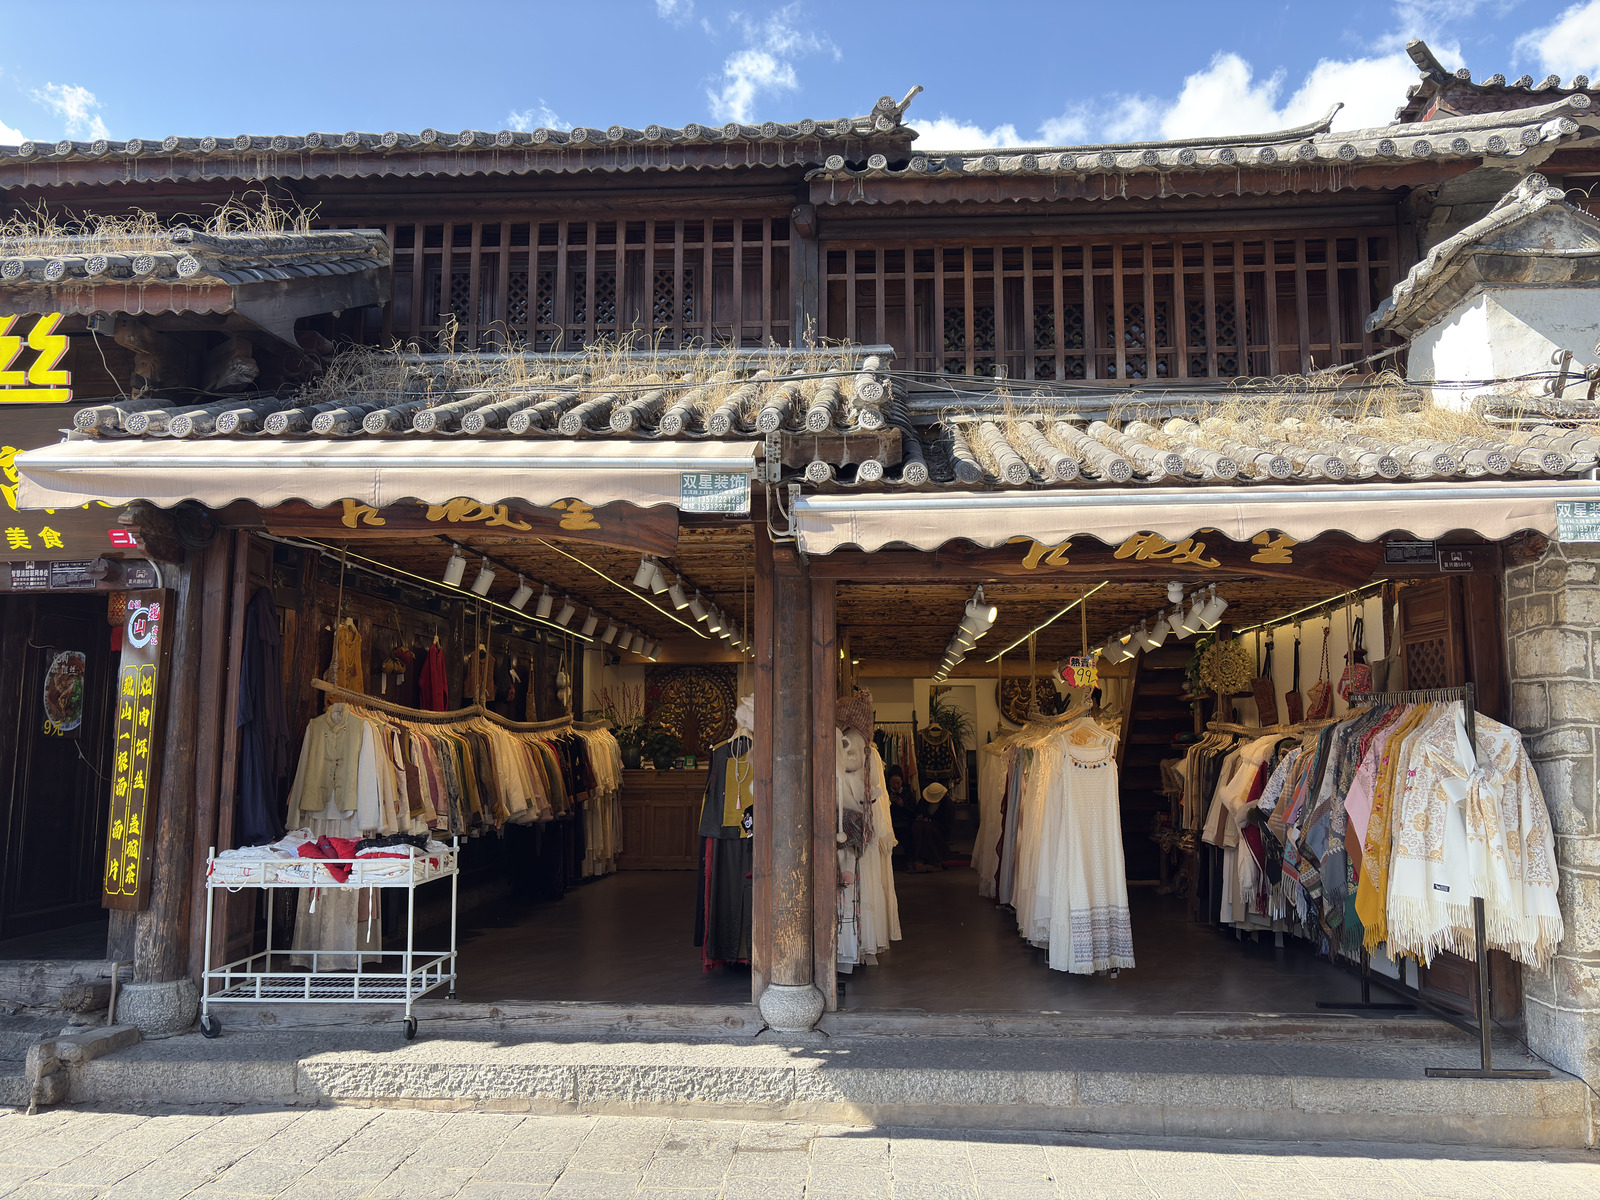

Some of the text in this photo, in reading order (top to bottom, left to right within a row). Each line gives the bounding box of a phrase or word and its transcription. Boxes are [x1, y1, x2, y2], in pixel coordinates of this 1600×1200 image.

[683, 474, 745, 489] 双星装饰
[697, 495, 745, 504] 13577221289
[697, 503, 745, 511] 15912271189
[5, 526, 65, 550] 美食
[44, 720, 64, 736] 9元
